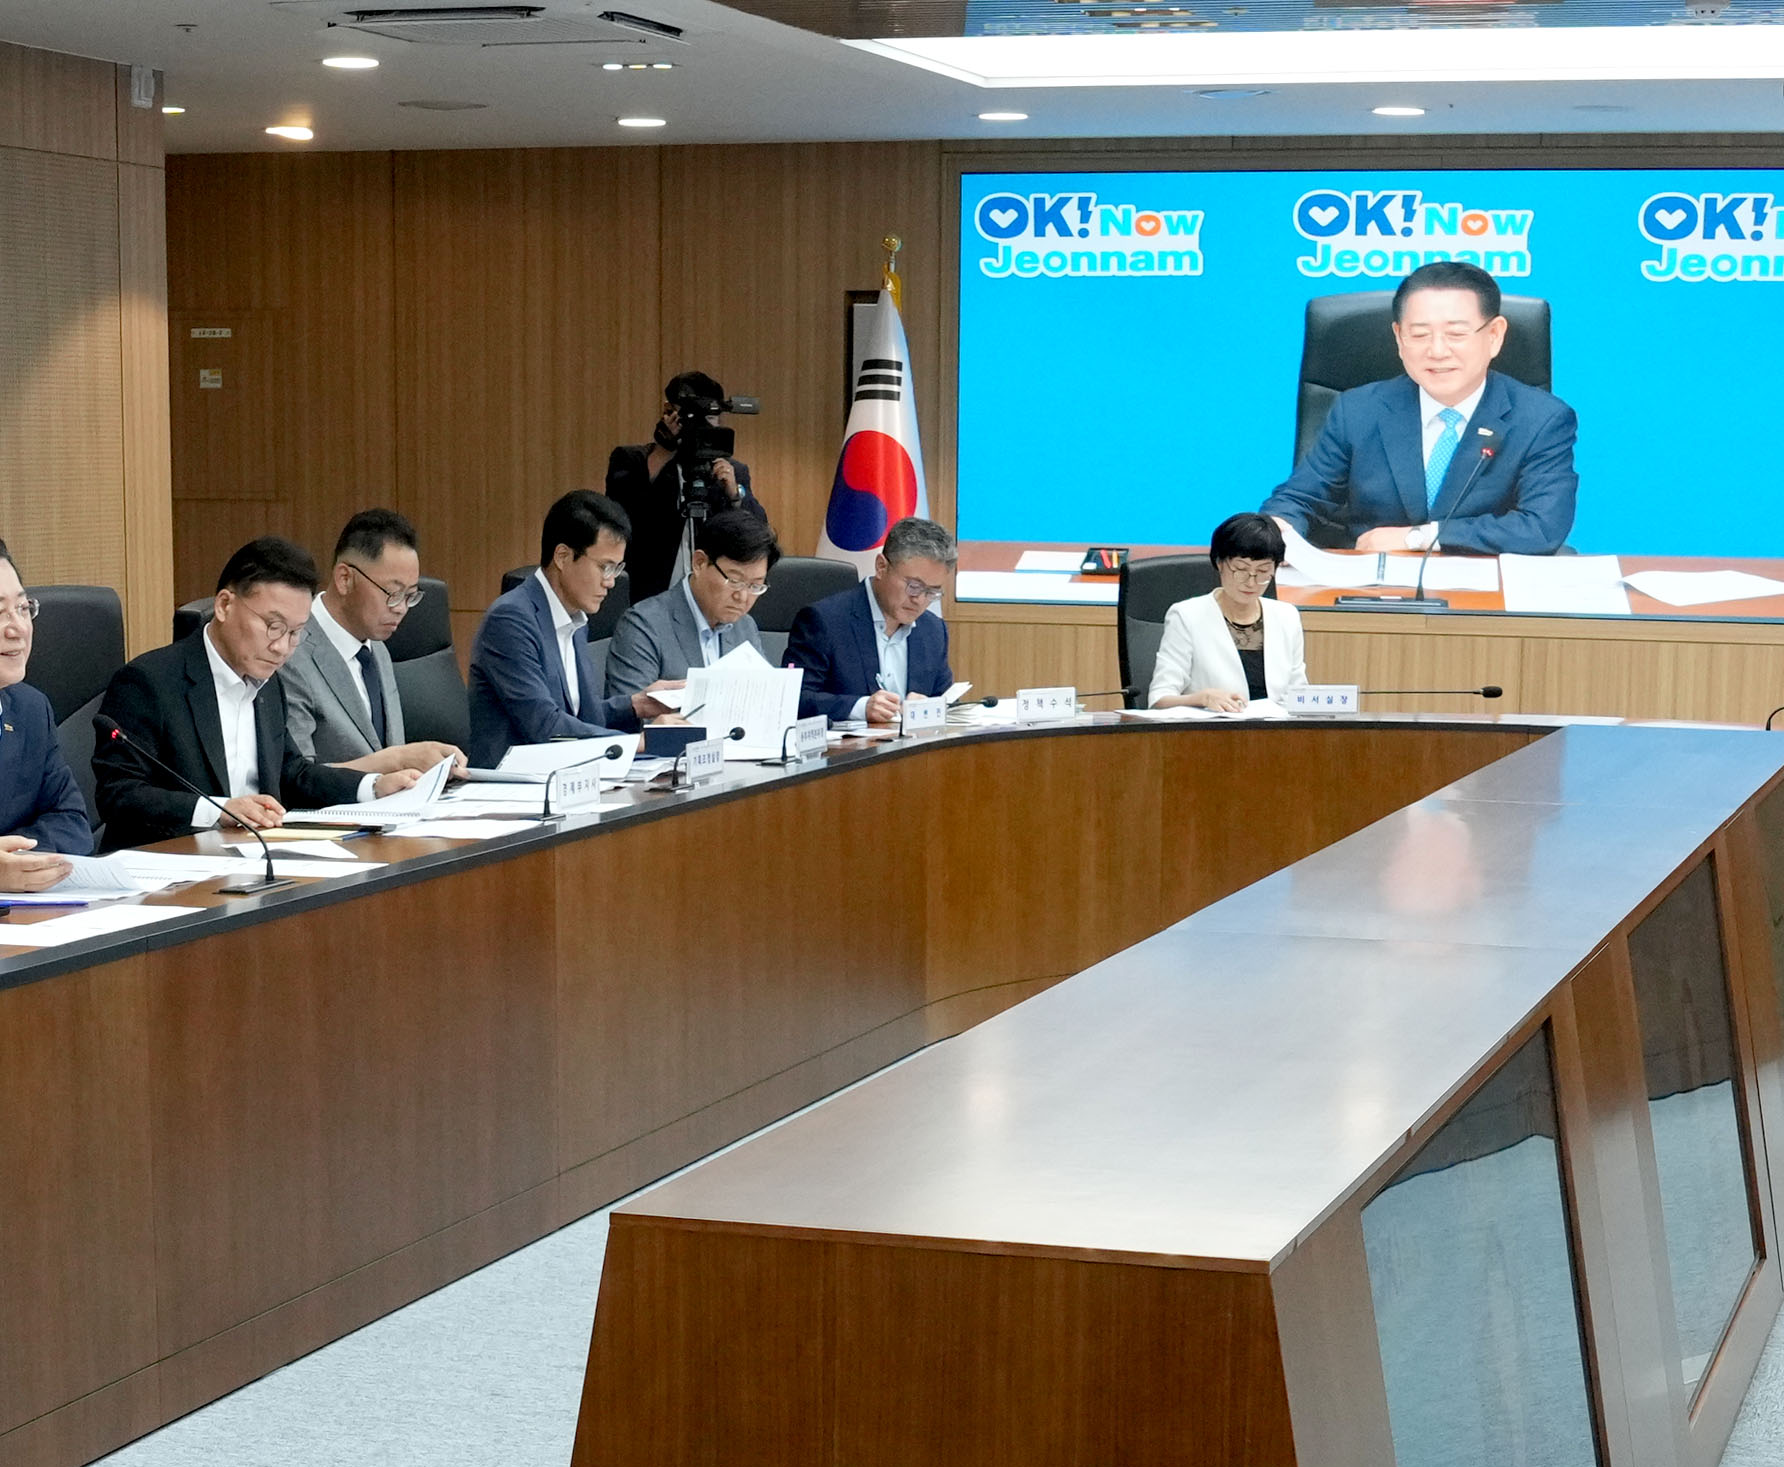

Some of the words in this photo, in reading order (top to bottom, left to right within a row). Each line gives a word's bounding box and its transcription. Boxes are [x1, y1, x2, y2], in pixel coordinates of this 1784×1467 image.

[979, 196, 1092, 238] OK!
[1100, 207, 1199, 237] Now
[1297, 193, 1417, 237] OK!
[1424, 206, 1529, 236] Now
[1643, 196, 1769, 241] OK!
[983, 245, 1199, 273] Jeonnam
[1297, 695, 1348, 704] 비서실장
